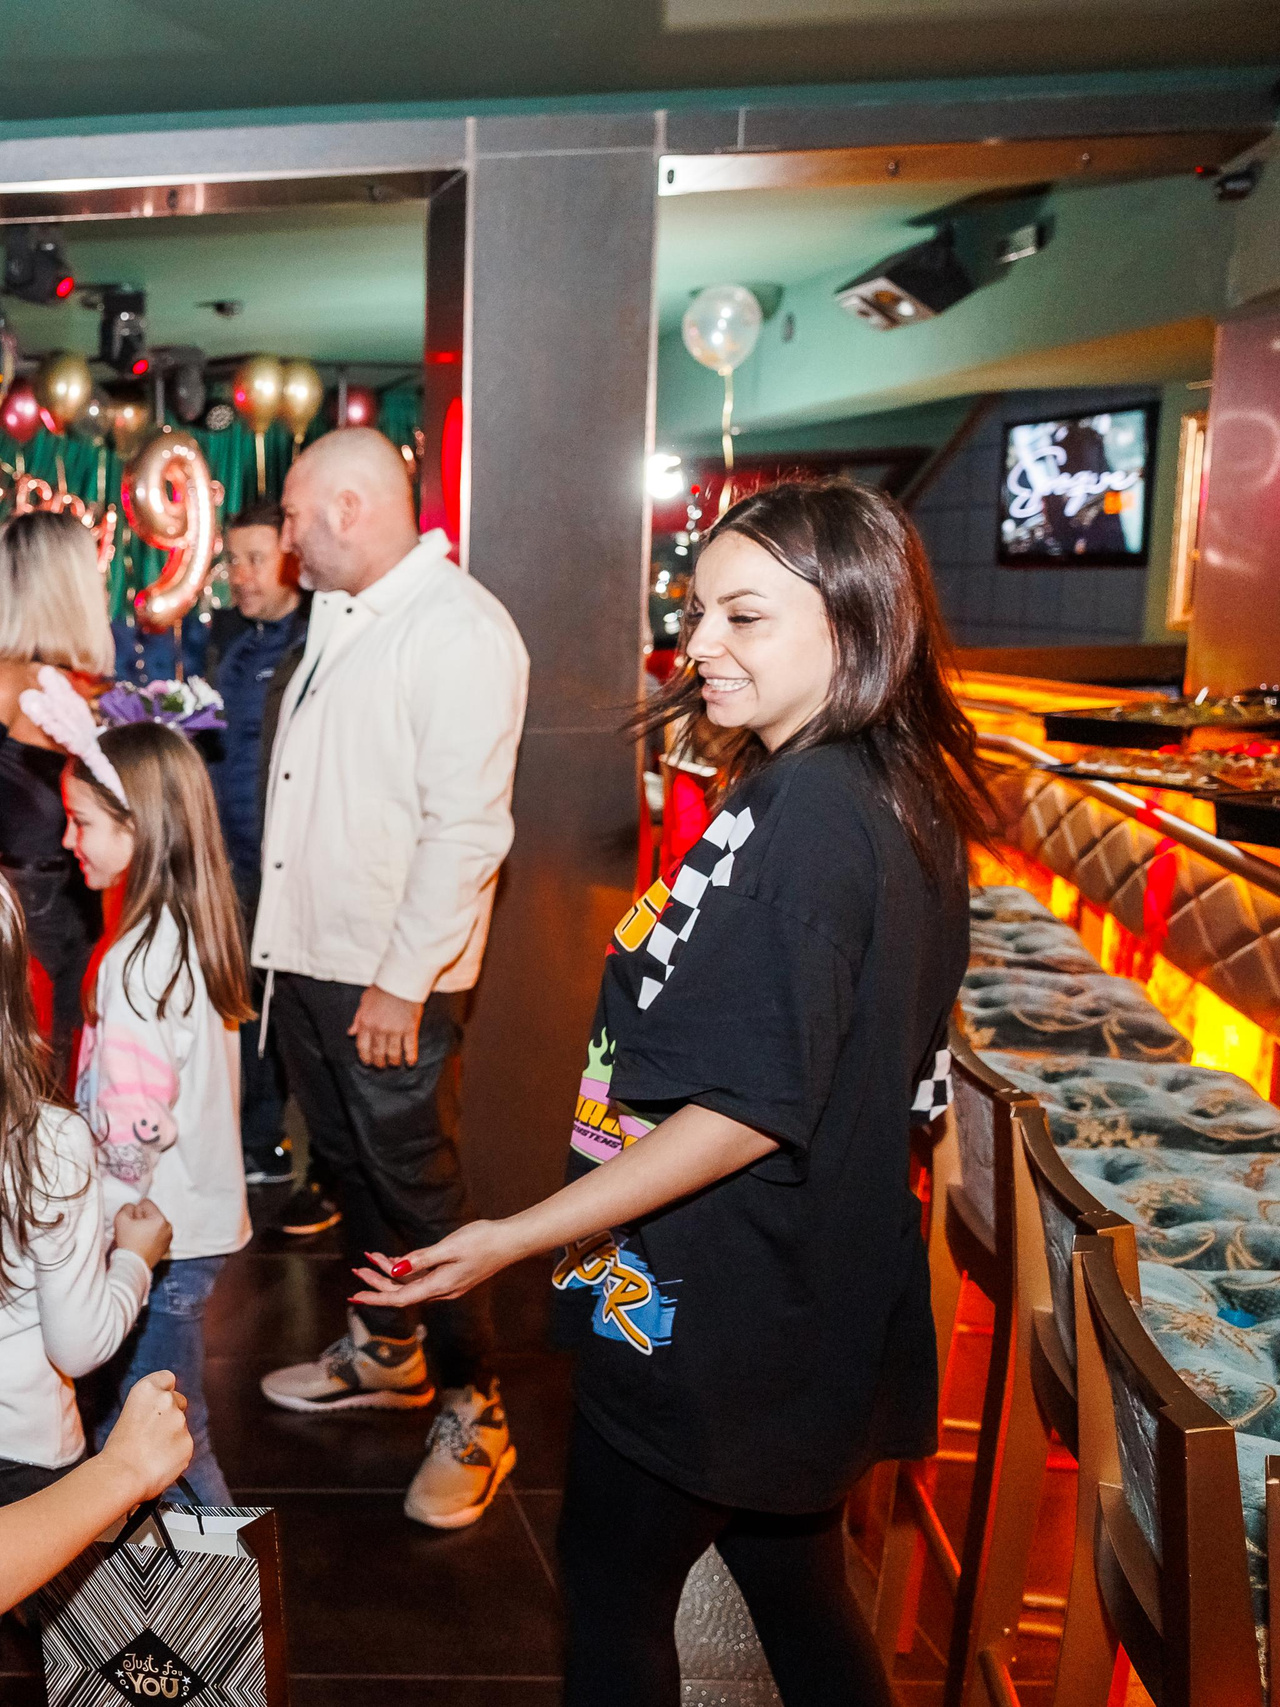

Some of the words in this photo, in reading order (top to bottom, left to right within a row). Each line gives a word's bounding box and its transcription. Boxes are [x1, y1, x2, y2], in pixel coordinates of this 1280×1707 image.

[122, 431, 213, 635] 9
[122, 1653, 159, 1673] Just
[125, 1671, 180, 1699] YOU
